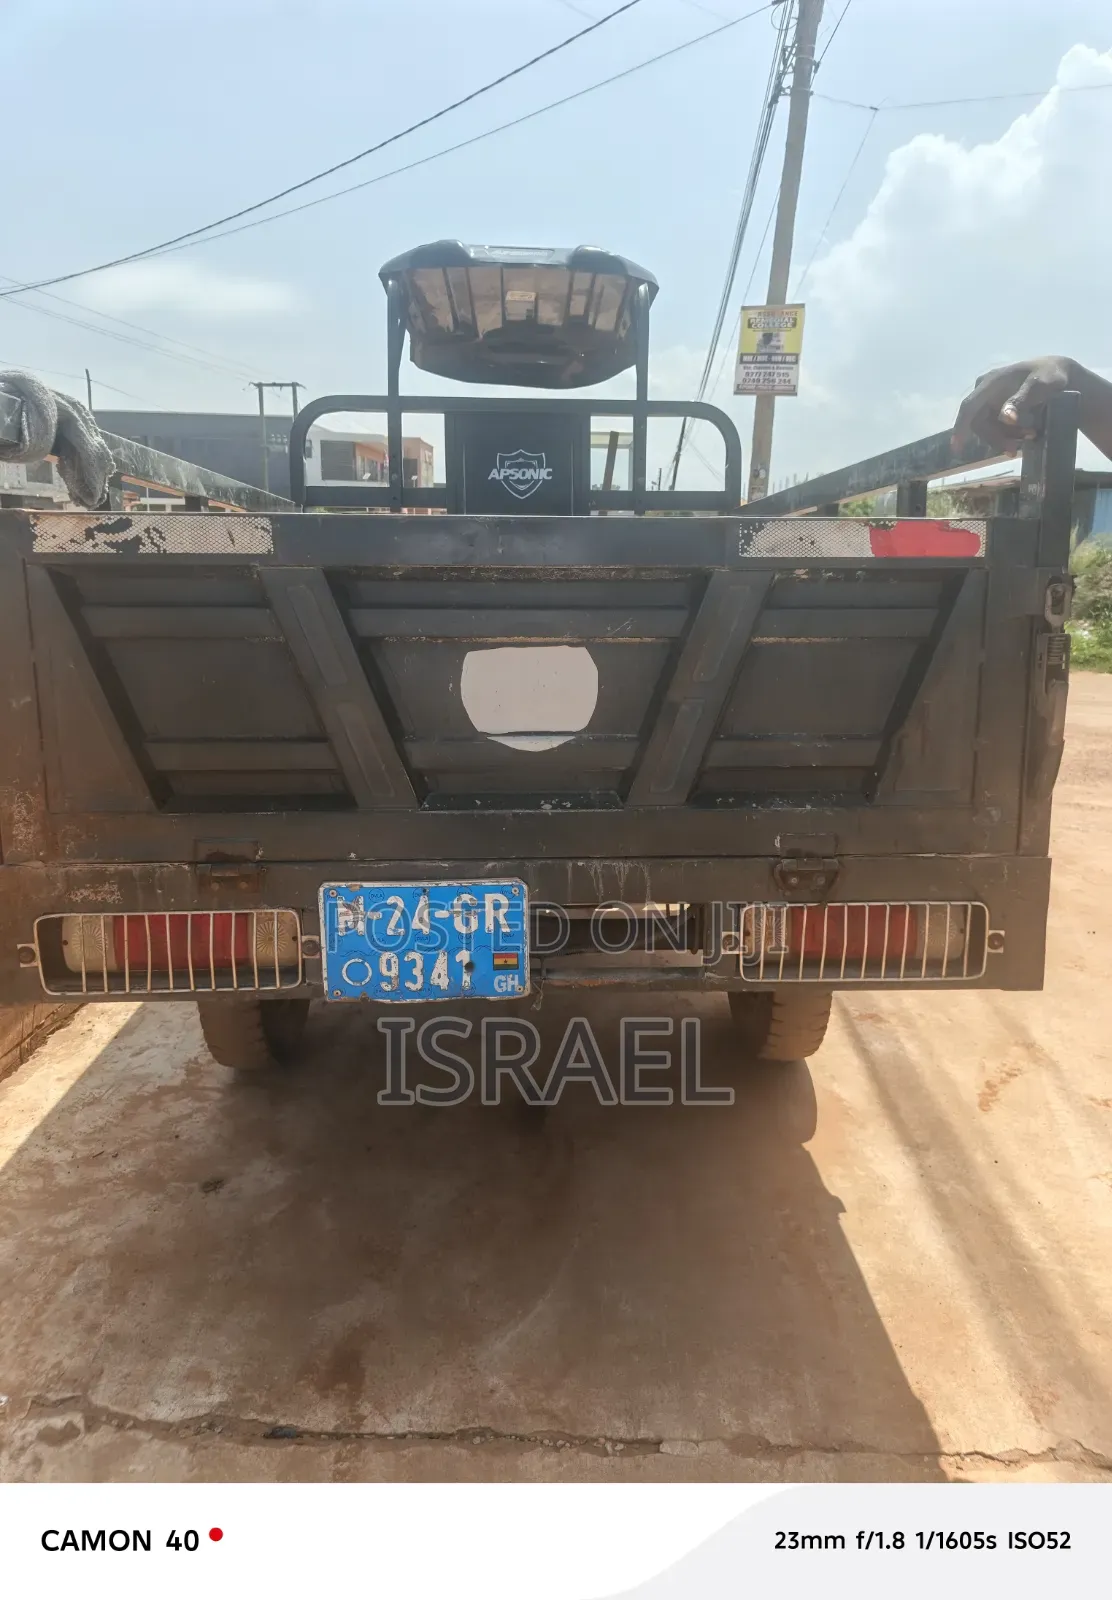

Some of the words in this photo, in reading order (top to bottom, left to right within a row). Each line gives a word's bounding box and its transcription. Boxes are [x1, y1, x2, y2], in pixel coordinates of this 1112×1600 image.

[488, 468, 553, 480] APSONIC
[380, 949, 471, 991] 9341
[494, 974, 519, 993] GH
